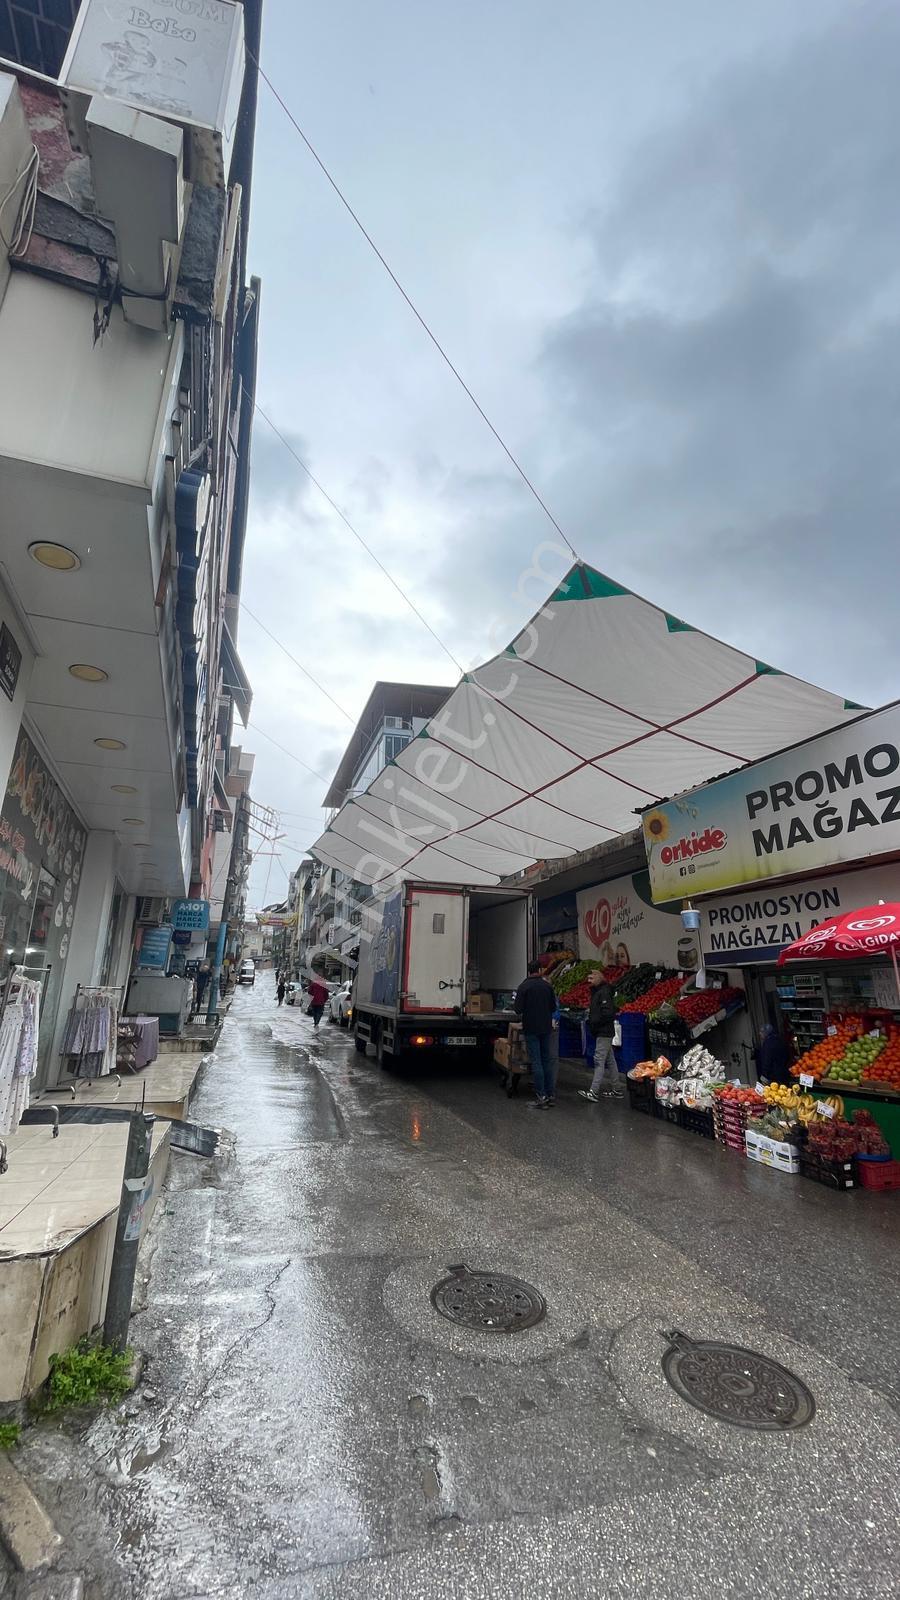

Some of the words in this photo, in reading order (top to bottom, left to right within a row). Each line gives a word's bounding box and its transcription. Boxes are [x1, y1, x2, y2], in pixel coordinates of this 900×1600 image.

[745, 743, 900, 820] PROMO
[752, 785, 900, 857] MAĞAZ
[591, 904, 610, 937] 40
[708, 886, 841, 926] PROMOSYON
